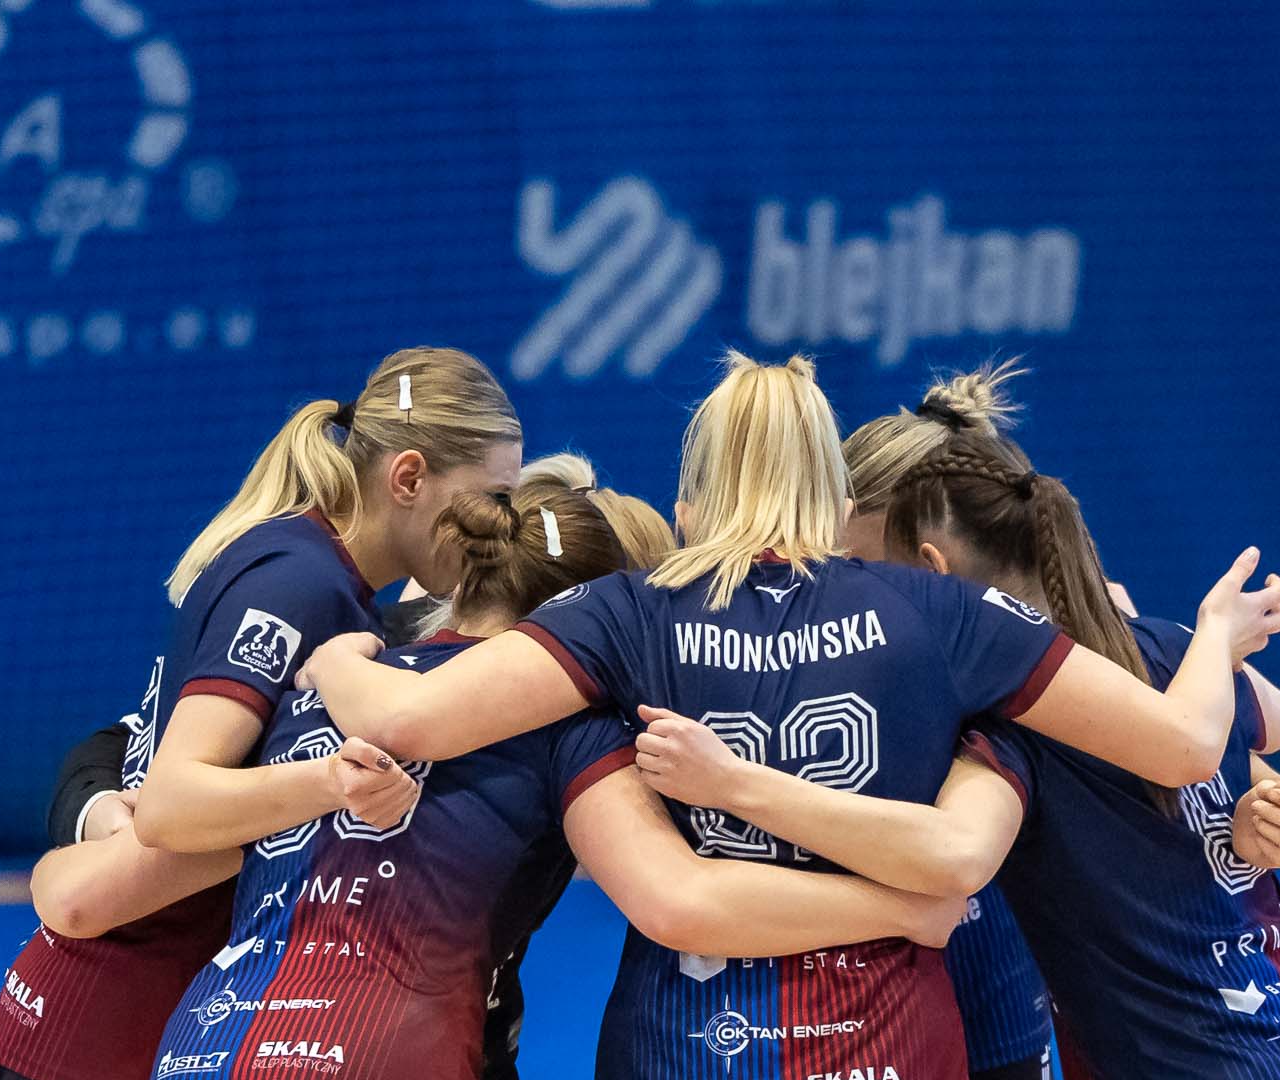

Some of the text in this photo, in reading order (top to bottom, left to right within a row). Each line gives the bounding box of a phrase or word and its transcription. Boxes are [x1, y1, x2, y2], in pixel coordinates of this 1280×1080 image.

[748, 197, 1080, 365] blejkan
[674, 609, 887, 672] WRONKOWSKA
[303, 942, 365, 957] STAL
[268, 1000, 336, 1011] ENERGY
[721, 1020, 865, 1040] OKTAN ENERGY
[257, 1041, 345, 1063] SKALA
[282, 1057, 342, 1076] PLASTYCZNY
